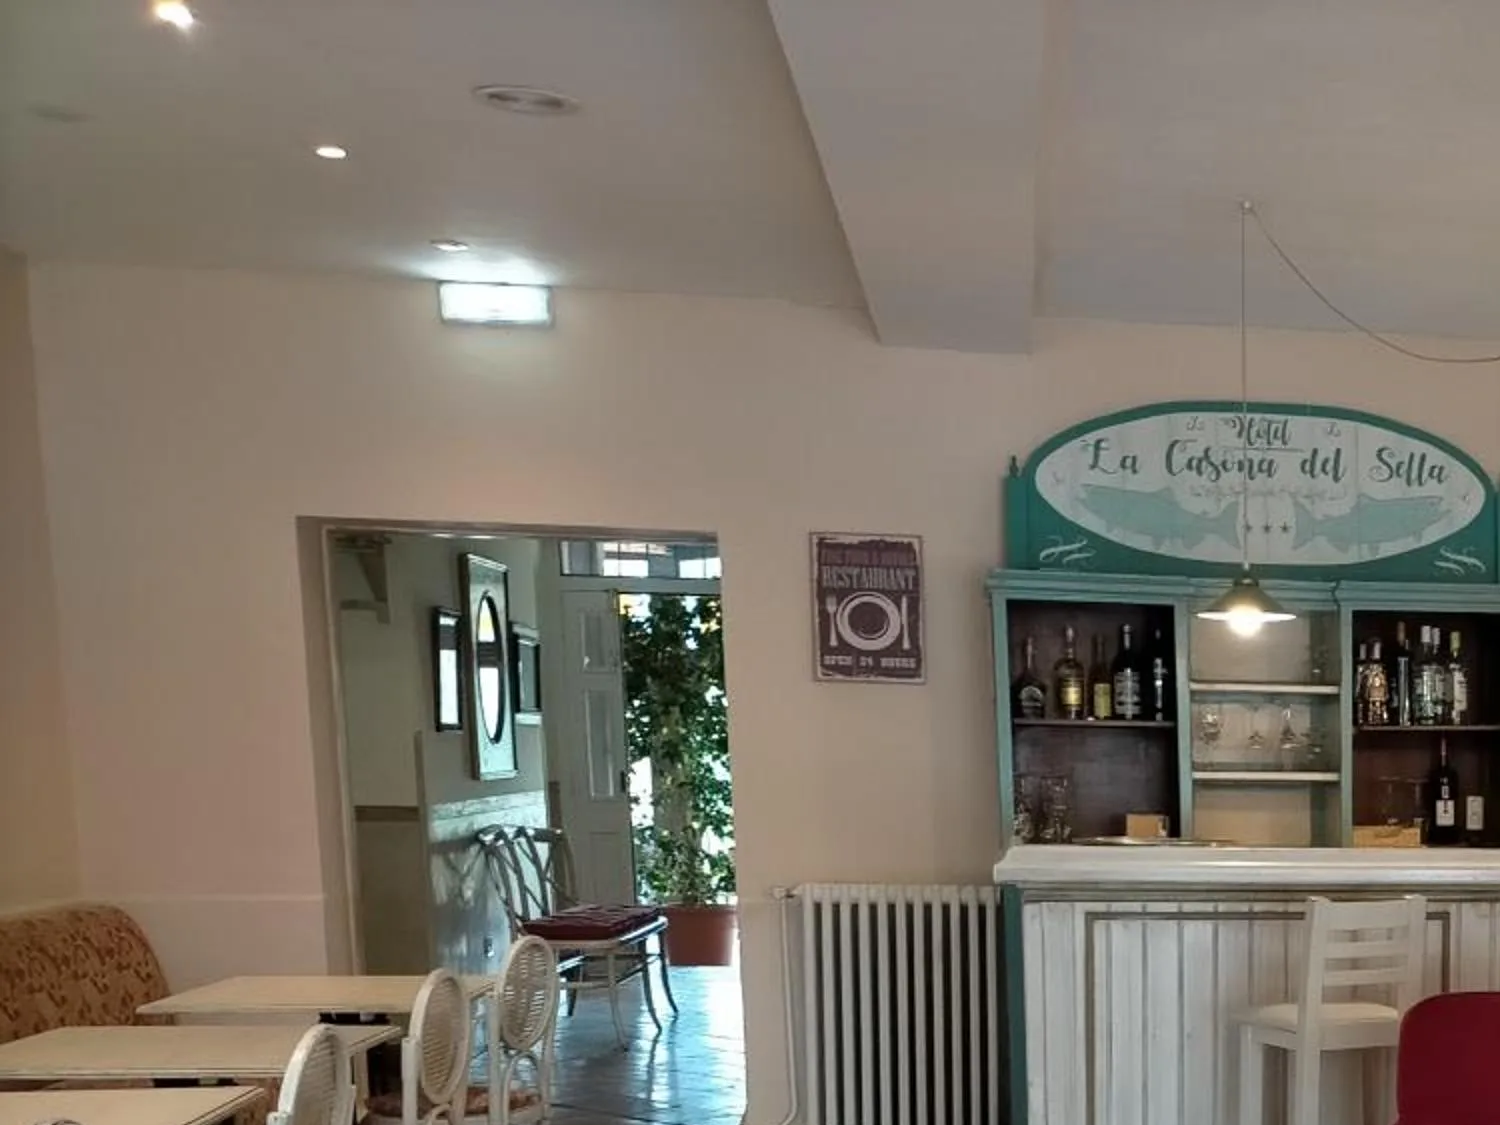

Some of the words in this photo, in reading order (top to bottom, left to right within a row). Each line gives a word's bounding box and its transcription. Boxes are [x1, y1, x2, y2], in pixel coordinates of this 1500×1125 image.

[1083, 437, 1138, 475] La
[1165, 439, 1278, 482] Casona
[1300, 447, 1346, 483] del
[1368, 446, 1448, 487] Sella
